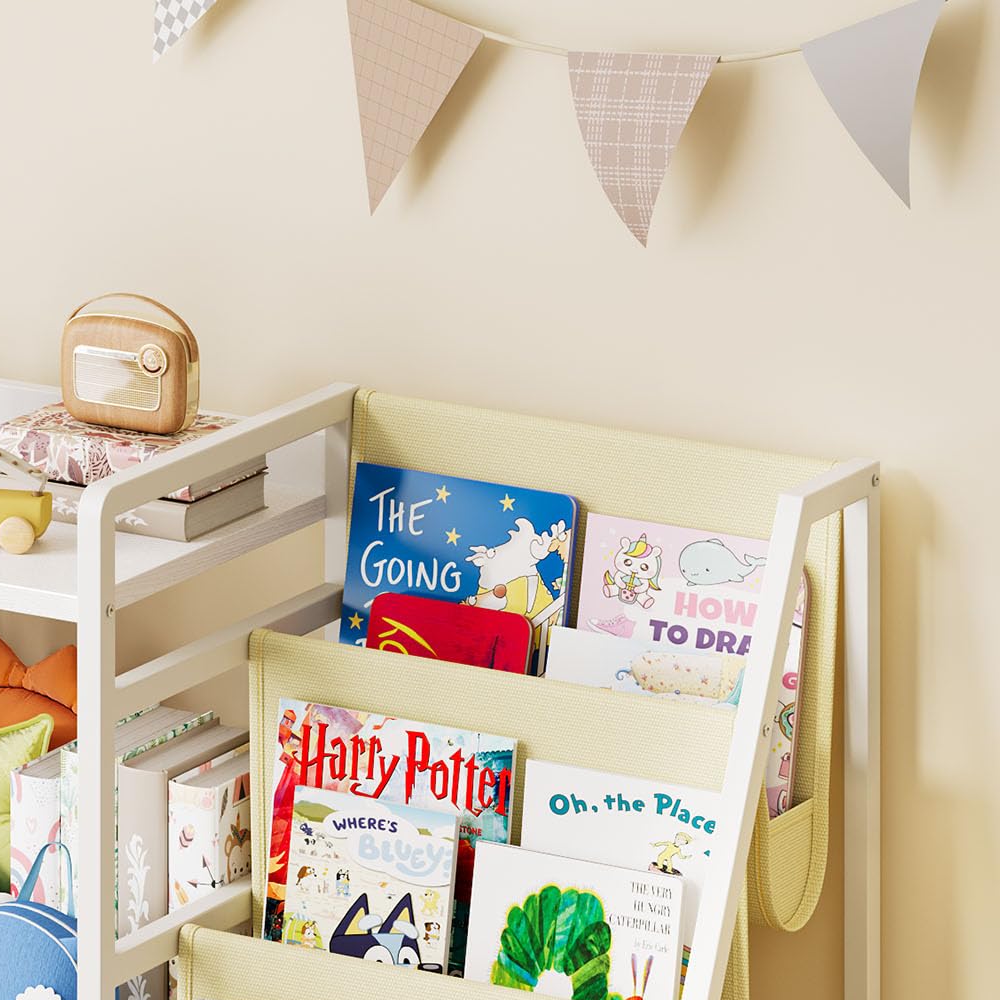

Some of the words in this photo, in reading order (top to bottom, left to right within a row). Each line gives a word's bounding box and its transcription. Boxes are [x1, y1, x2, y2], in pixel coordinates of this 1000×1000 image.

[369, 487, 433, 536] THE
[360, 540, 462, 593] GOING
[674, 591, 758, 627] HOW
[650, 619, 689, 645] TO
[293, 722, 400, 799] Harry
[404, 730, 513, 818] Potter
[333, 817, 398, 833] WHERE'S
[549, 793, 598, 816] Oh,
[603, 793, 646, 812] the
[653, 793, 717, 834] Place
[630, 881, 649, 896] THE
[651, 885, 672, 900] VERY
[608, 913, 671, 935] CATERPILLAR
[633, 900, 671, 917] HUNGRY
